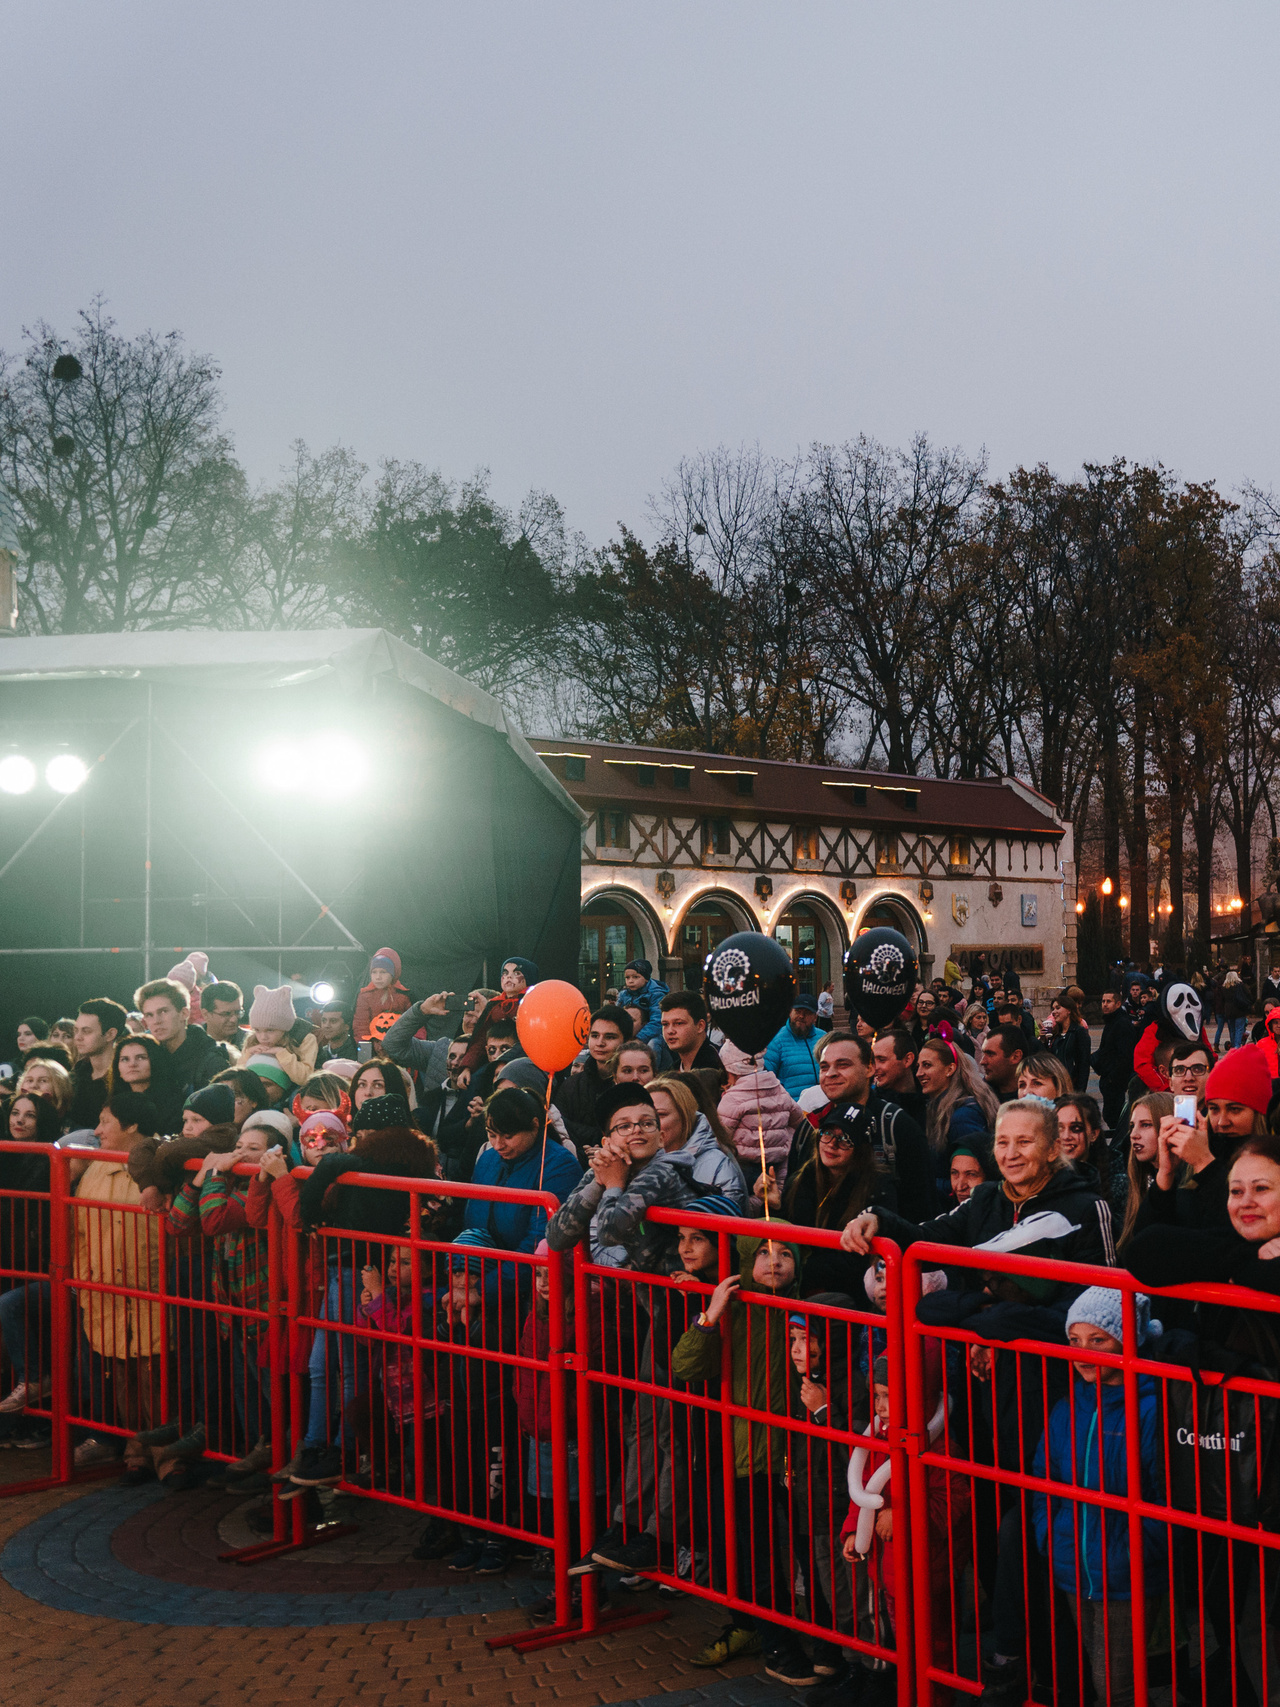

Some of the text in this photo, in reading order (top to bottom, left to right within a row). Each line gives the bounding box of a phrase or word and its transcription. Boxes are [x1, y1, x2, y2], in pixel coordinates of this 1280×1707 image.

[959, 949, 1043, 971] АОДРОМ
[862, 978, 908, 996] HALLOWEEN
[709, 987, 760, 1010] HALLOWEEN
